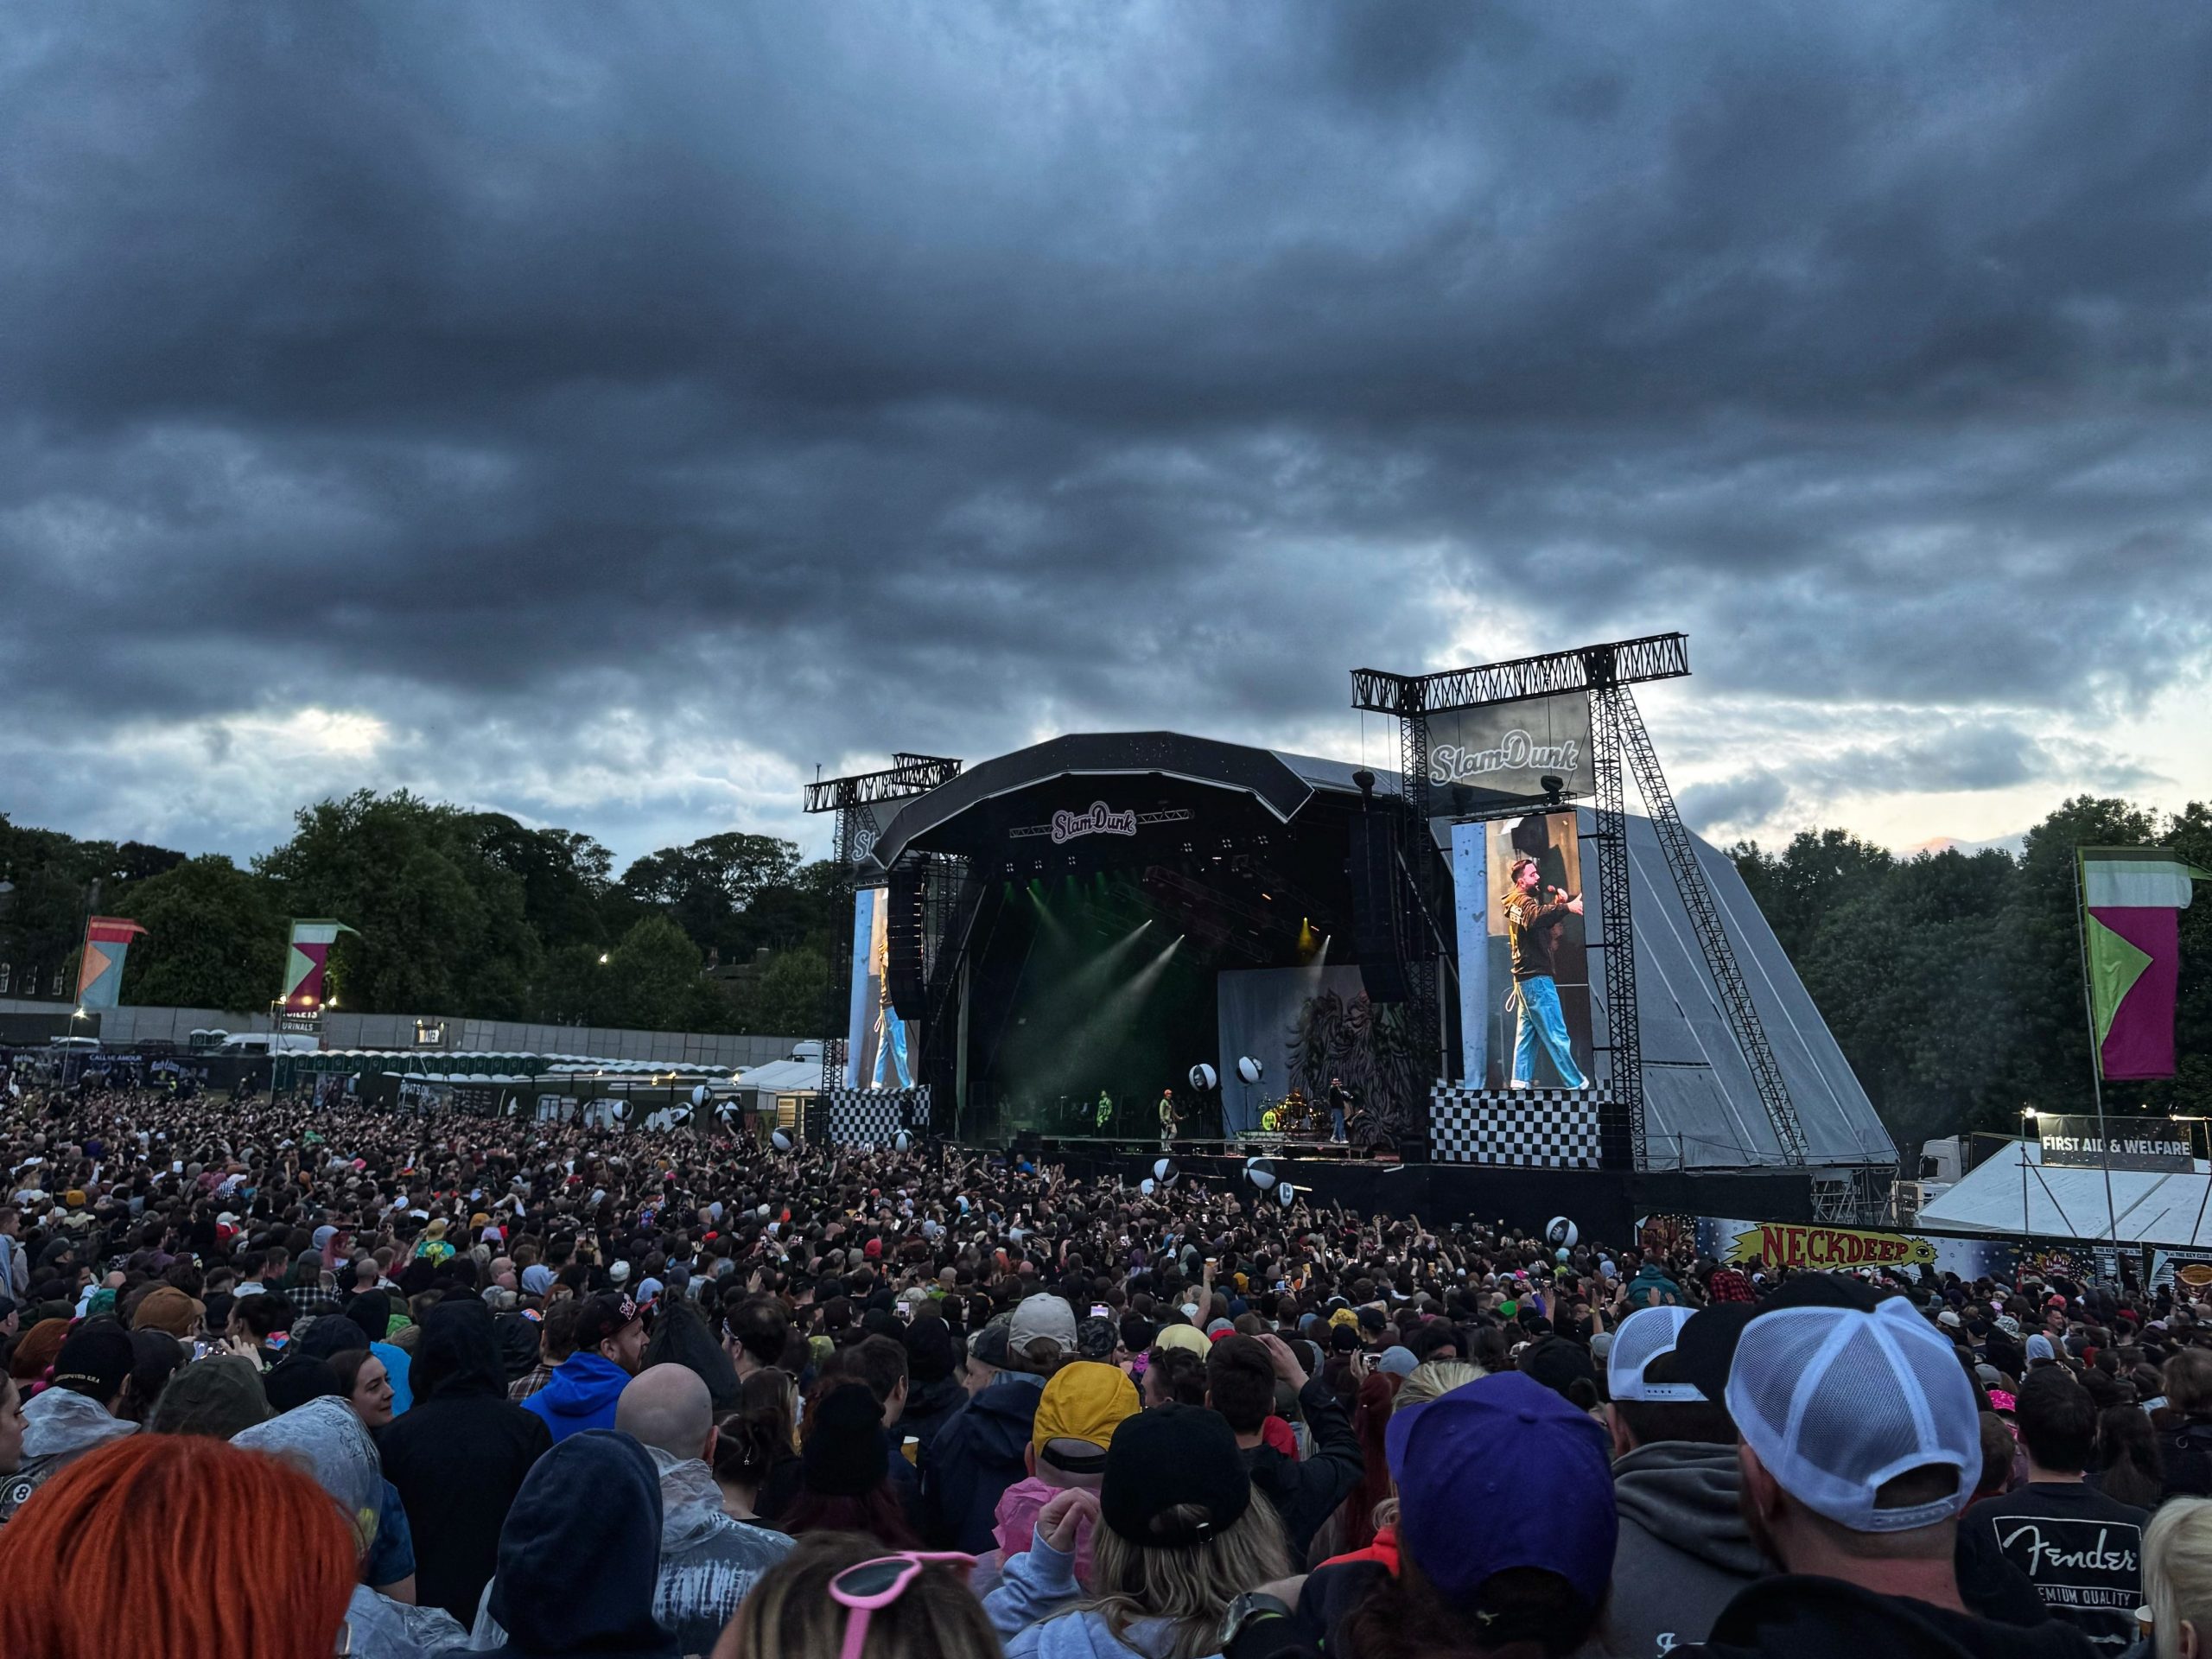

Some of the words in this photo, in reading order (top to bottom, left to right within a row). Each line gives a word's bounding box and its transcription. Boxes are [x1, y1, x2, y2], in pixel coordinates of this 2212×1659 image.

[282, 1021, 314, 1032] URINALS
[2043, 1135, 2080, 1152] FIRST
[2110, 1139, 2121, 1154] &
[2124, 1140, 2192, 1156] WELFARE
[16, 1486, 29, 1501] 8
[2002, 1525, 2137, 1576] Fender
[2082, 1589, 2131, 1606] QUALITY
